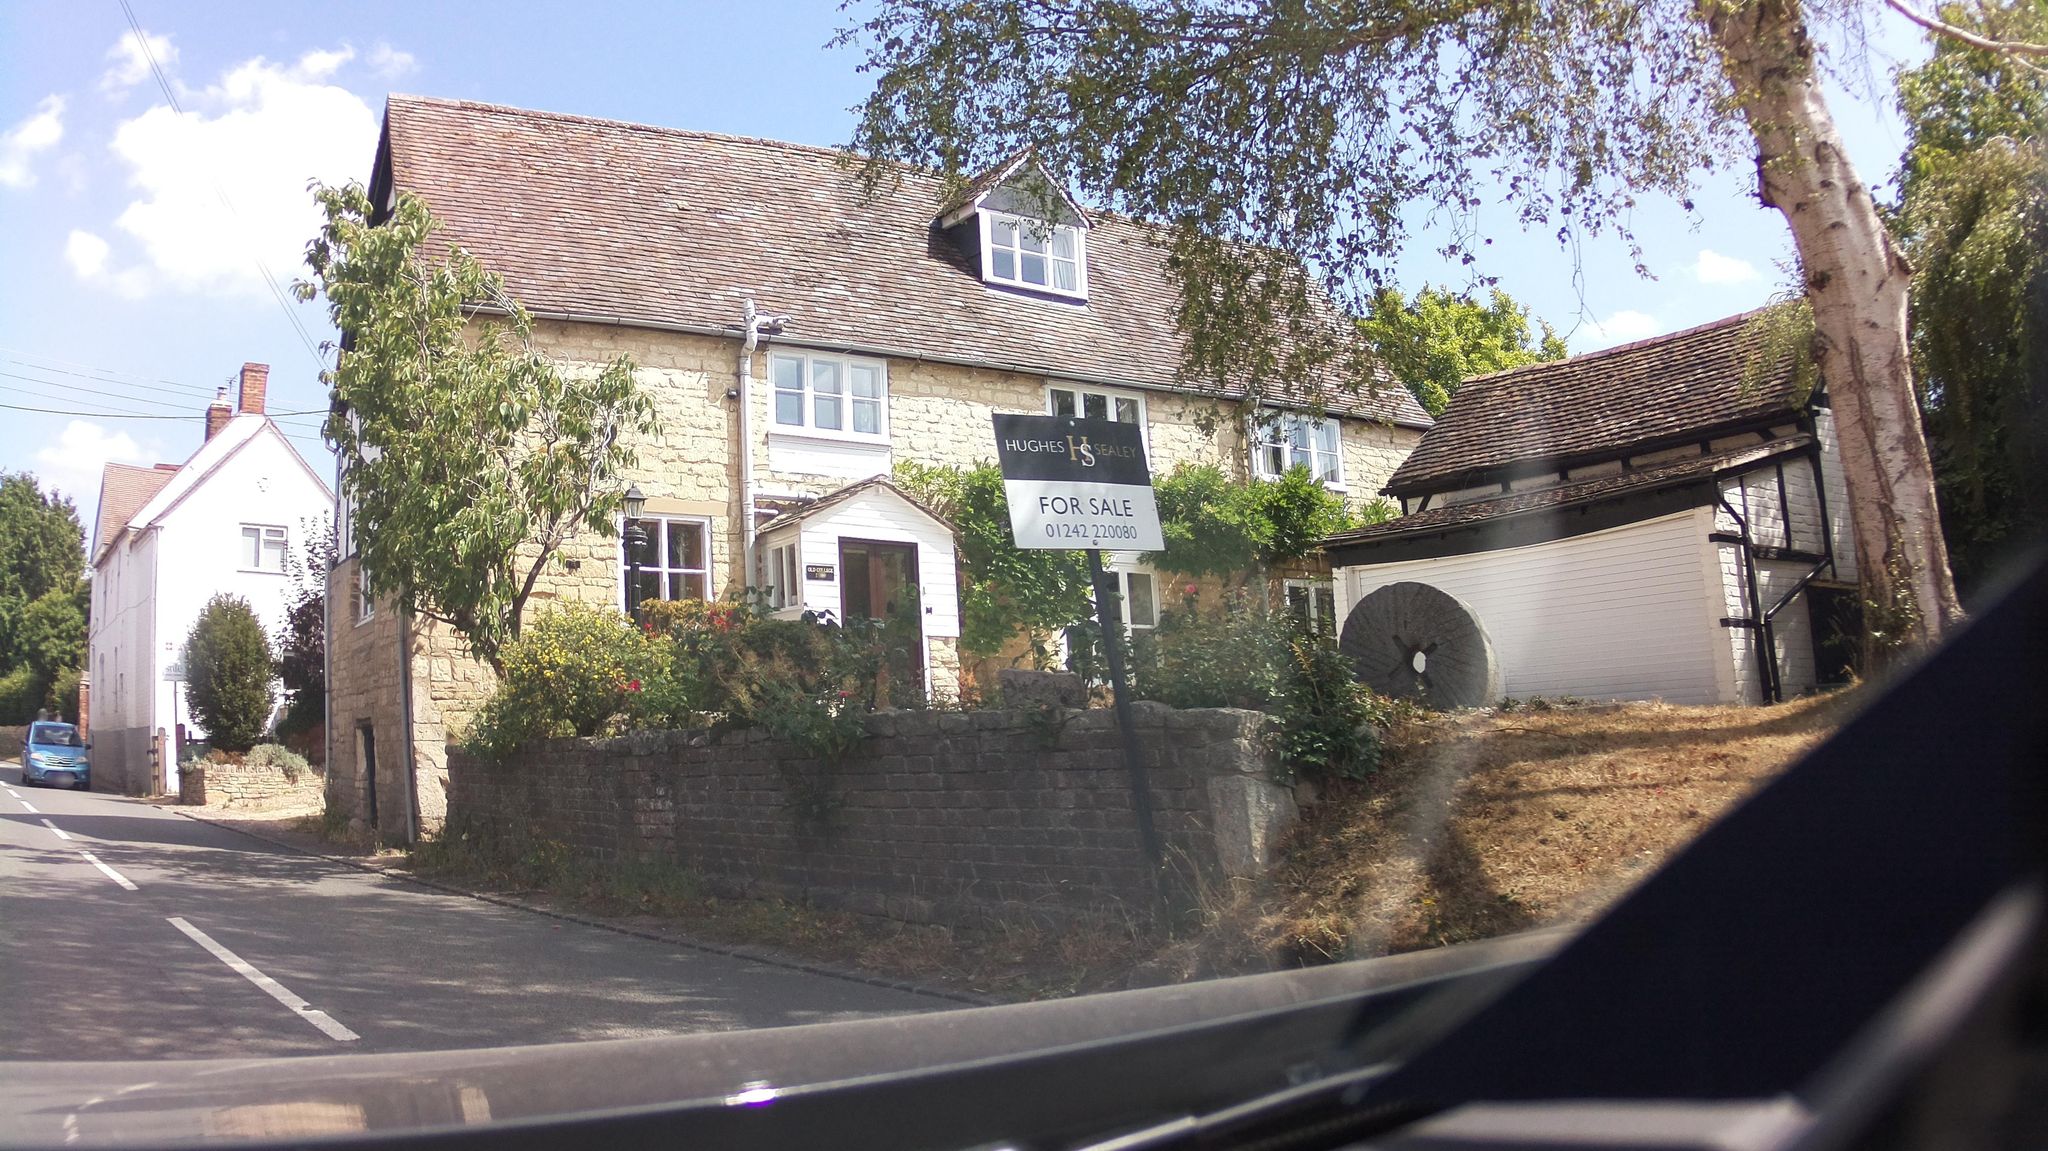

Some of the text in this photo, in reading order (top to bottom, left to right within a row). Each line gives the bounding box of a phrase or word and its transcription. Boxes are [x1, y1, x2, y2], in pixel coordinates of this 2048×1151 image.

[1005, 439, 1065, 453] HUGHES
[1094, 443, 1137, 458] SEALEY
[1039, 496, 1134, 517] FOR SALE
[1045, 524, 1138, 539] 01242 220080
